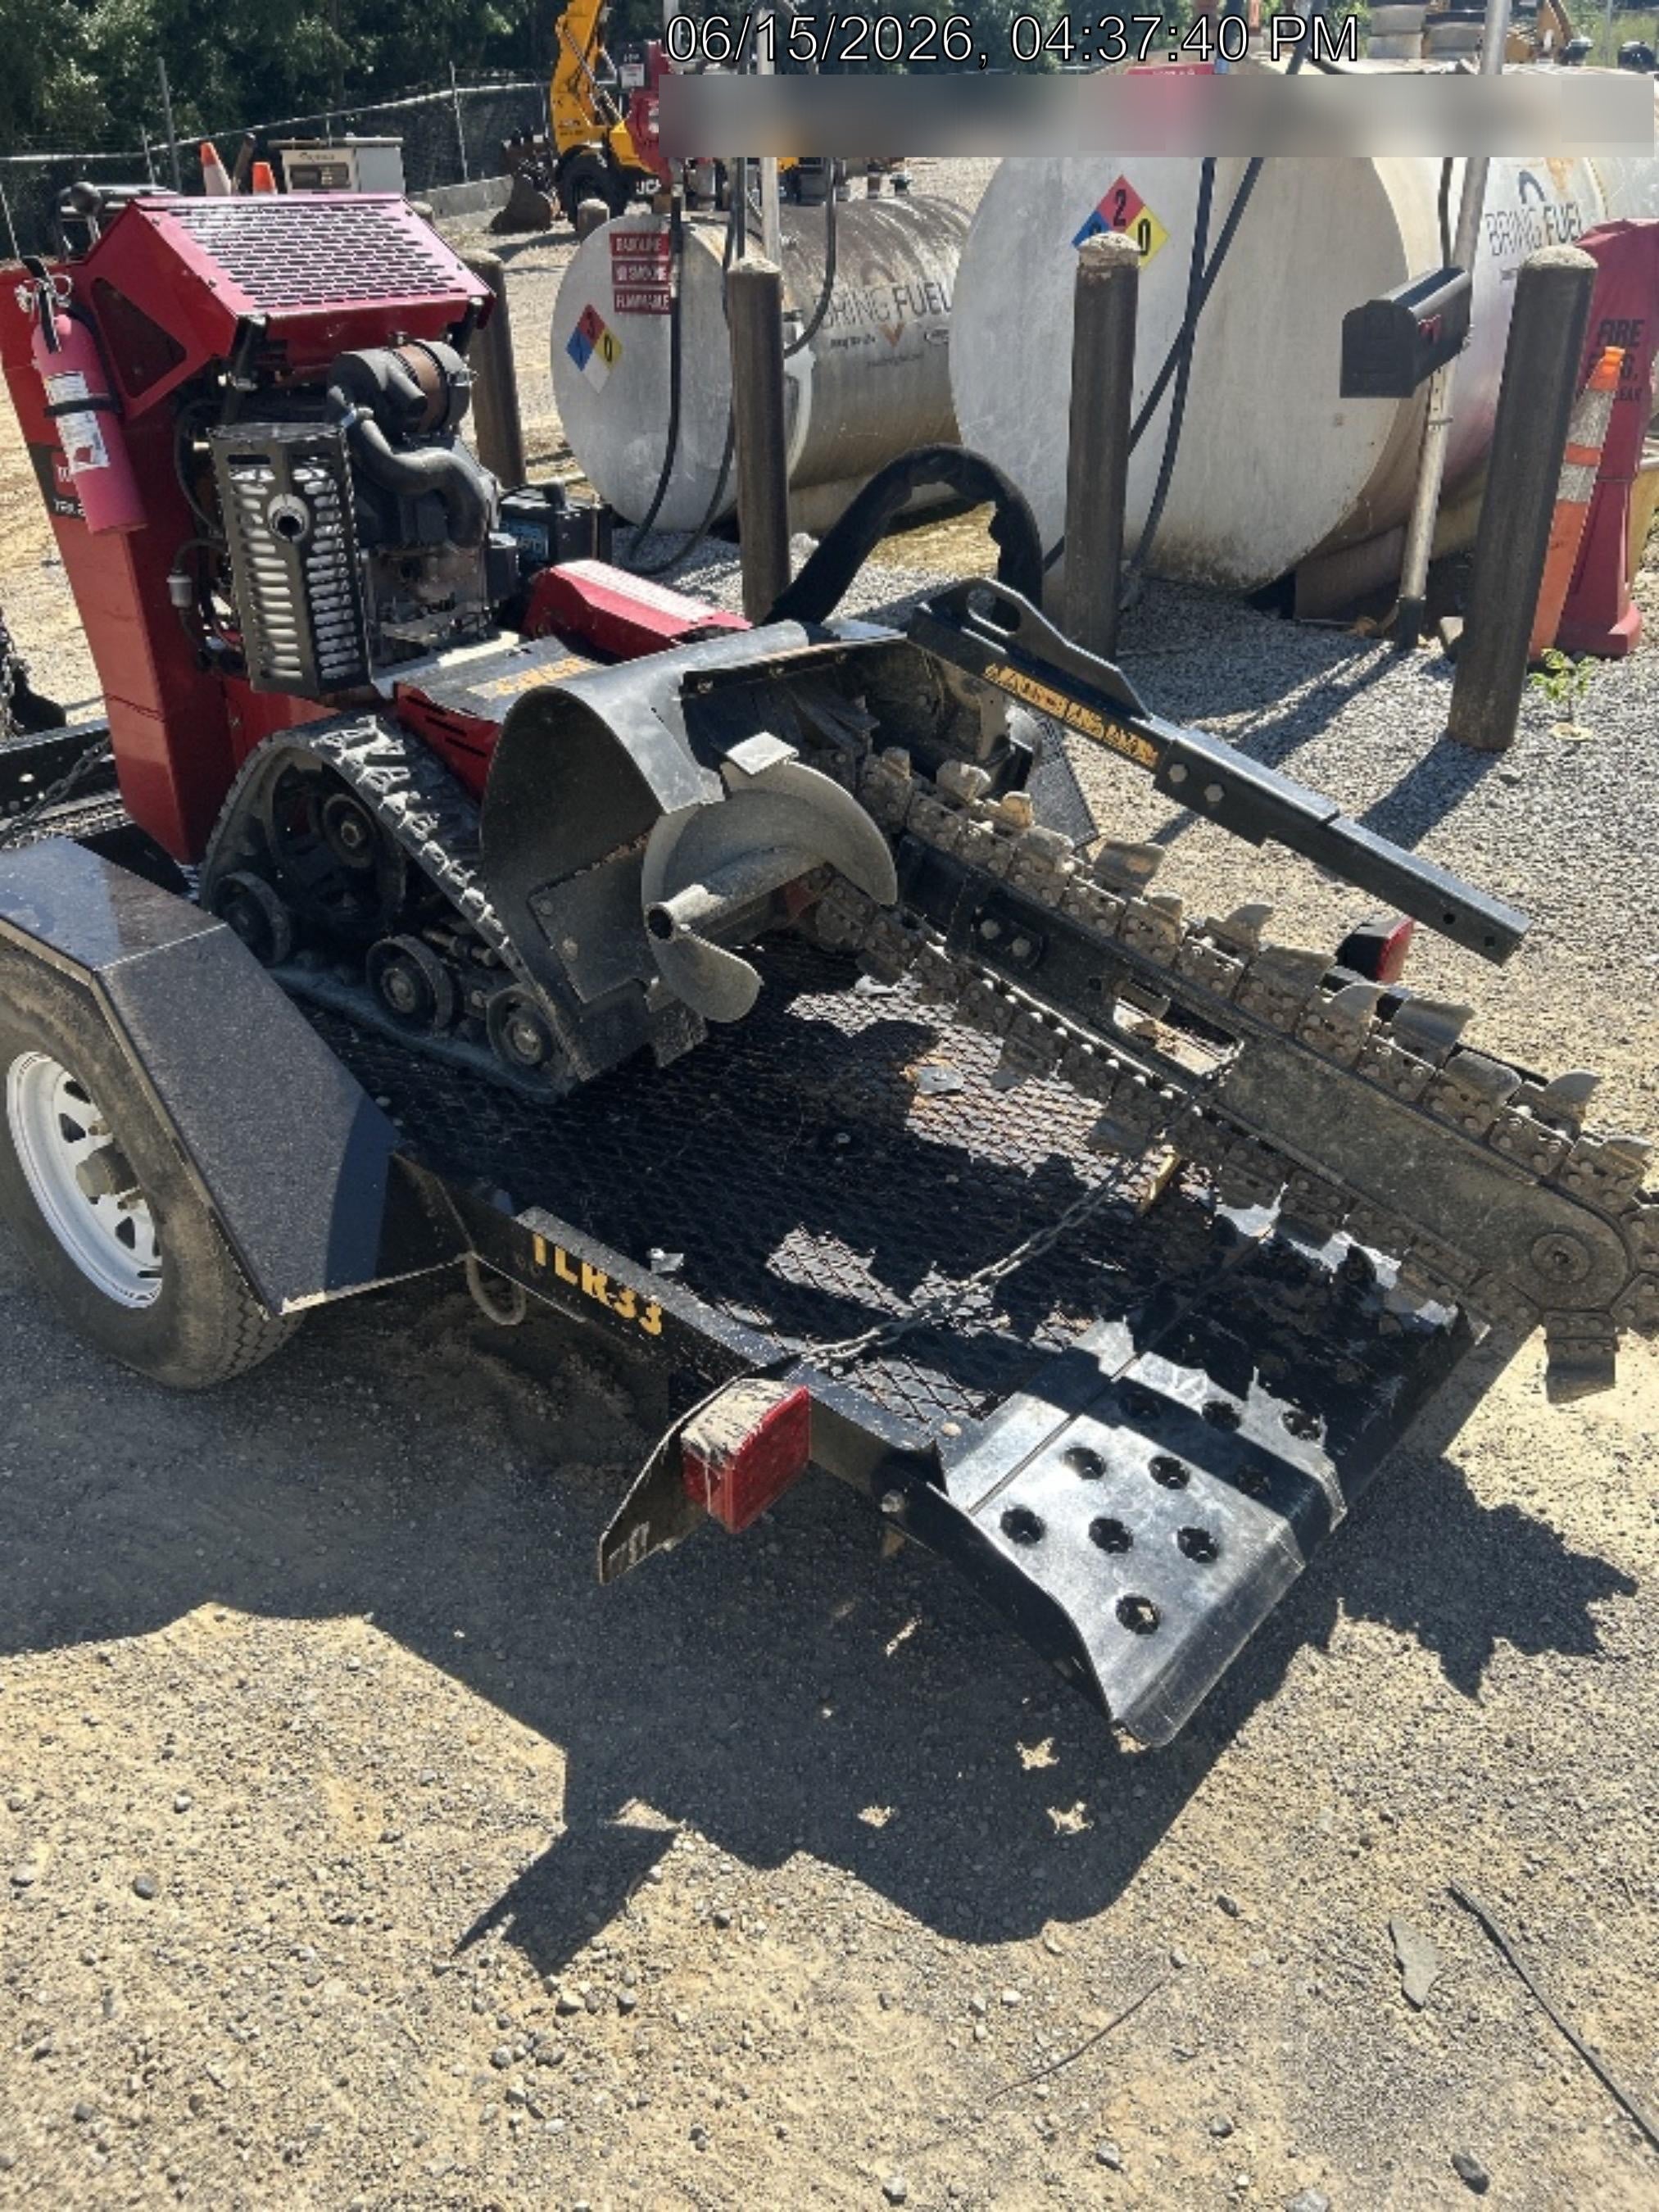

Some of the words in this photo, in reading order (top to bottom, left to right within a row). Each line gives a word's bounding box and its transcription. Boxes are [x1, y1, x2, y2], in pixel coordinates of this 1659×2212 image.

[1113, 189, 1126, 226] 2
[1544, 202, 1583, 246] FUEL
[1138, 219, 1150, 256] 0
[604, 334, 612, 362] 0
